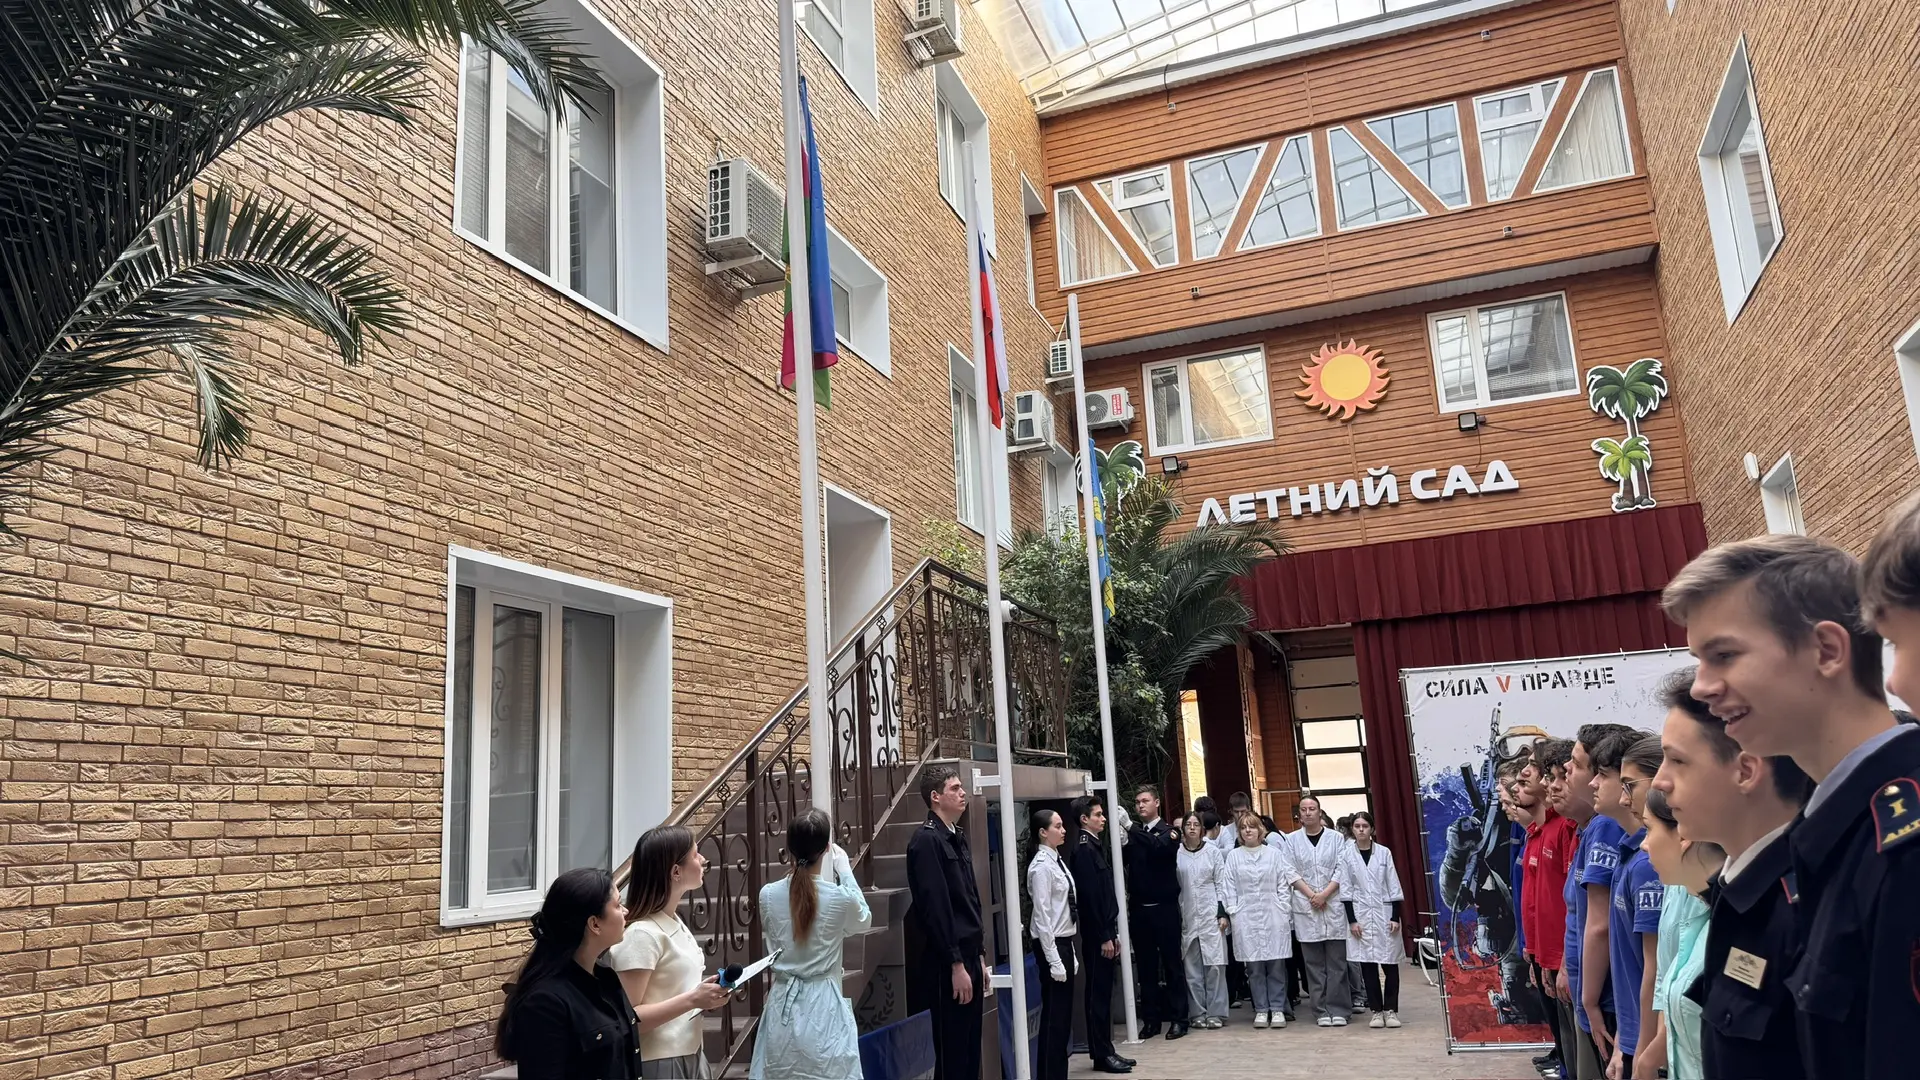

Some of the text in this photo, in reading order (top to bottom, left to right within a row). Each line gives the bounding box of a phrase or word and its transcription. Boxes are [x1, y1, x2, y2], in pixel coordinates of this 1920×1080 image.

[1196, 460, 1519, 527] ЛЕТНИЙ САД
[1425, 666, 1616, 698] СИЛА V ПРАВДЕ
